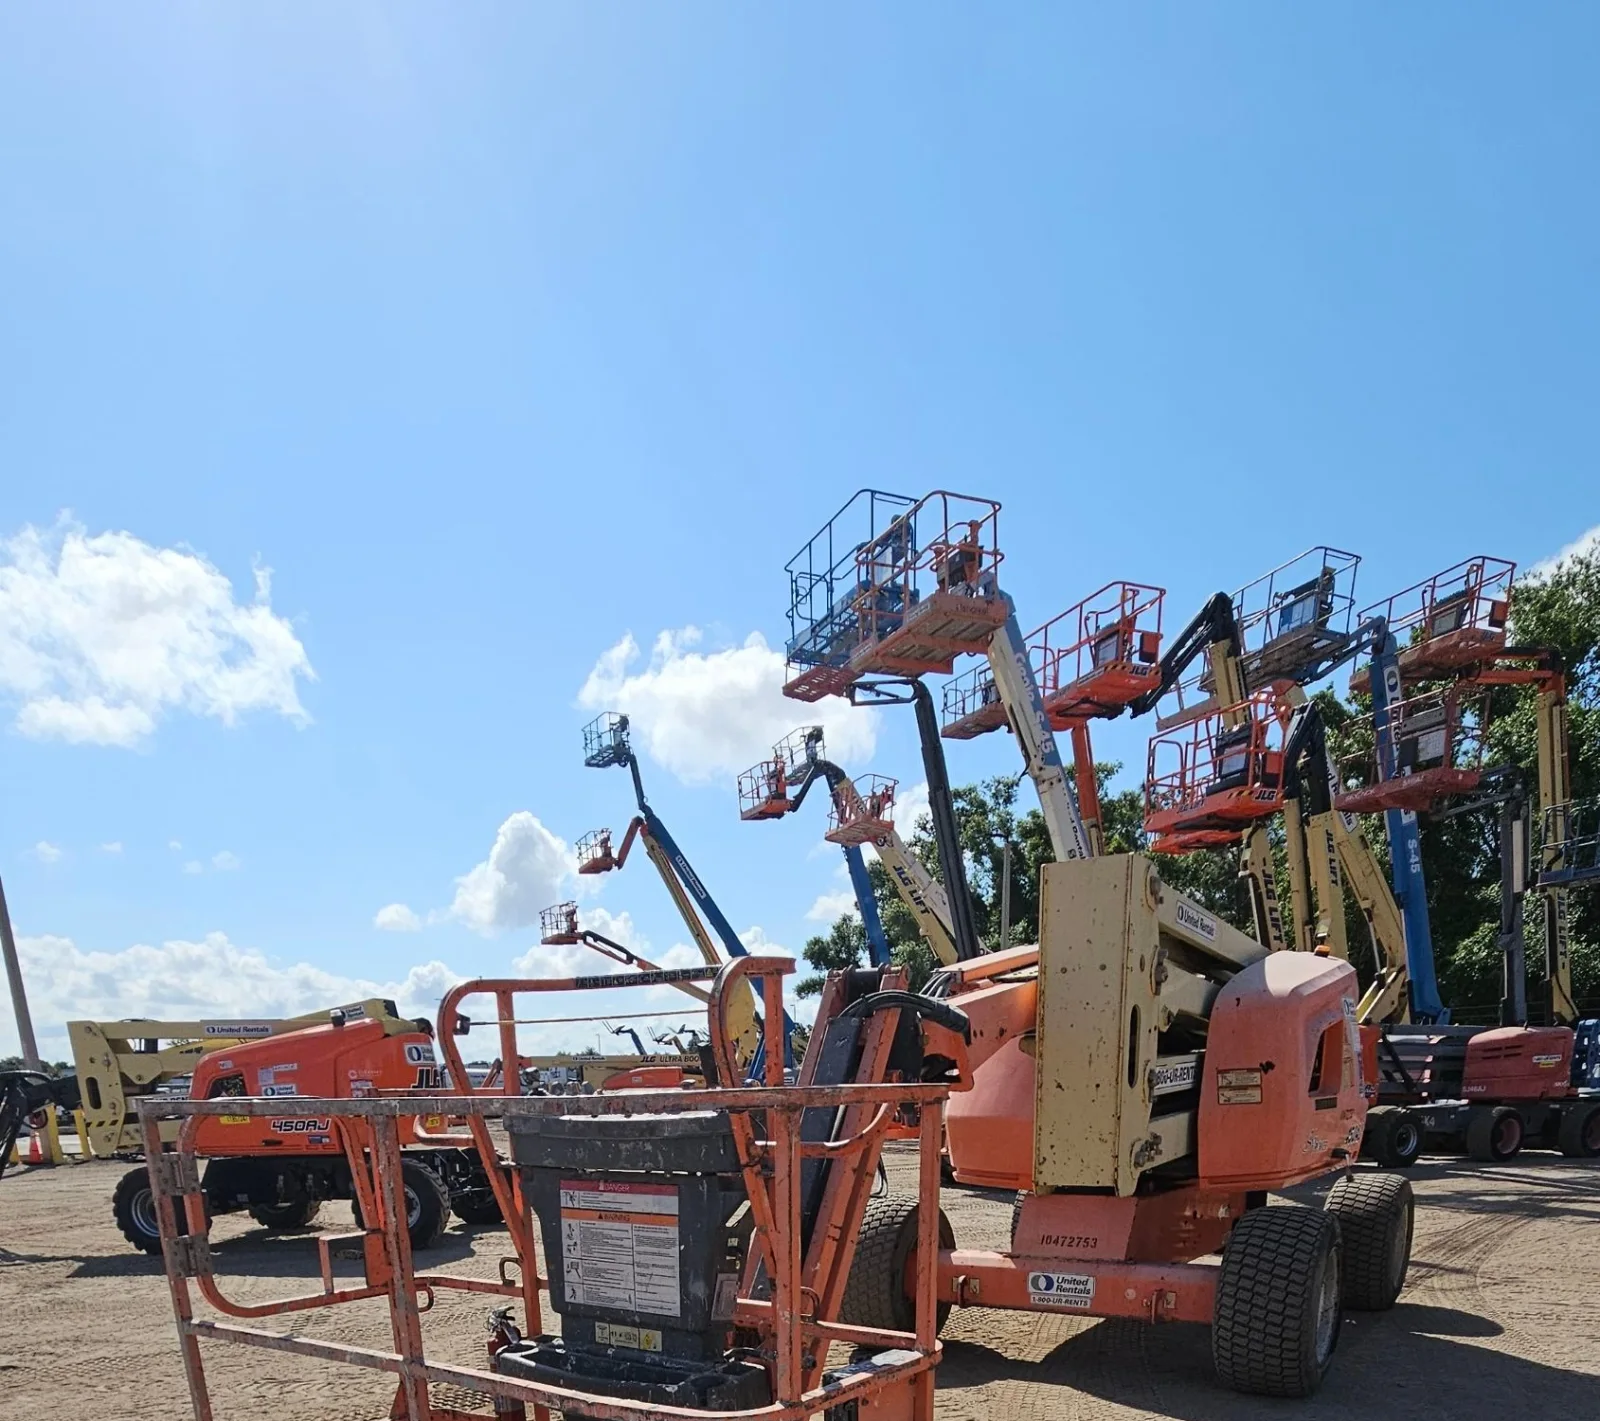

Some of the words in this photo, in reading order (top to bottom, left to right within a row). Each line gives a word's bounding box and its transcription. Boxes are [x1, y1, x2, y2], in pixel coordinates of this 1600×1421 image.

[1129, 666, 1149, 676] JLG
[1255, 790, 1275, 800] JLG
[1326, 829, 1335, 854] JLG
[1408, 838, 1421, 874] S-45
[1329, 858, 1339, 887] LIFT
[893, 865, 913, 887] JLG
[908, 890, 930, 914] LIFT
[1262, 869, 1277, 900] JLG
[1184, 909, 1199, 928] United
[1200, 917, 1215, 937] Rentals
[1268, 907, 1284, 943] LIFT
[217, 1025, 241, 1034] United
[242, 1025, 269, 1034] Rentals
[641, 1055, 656, 1063] JLG
[660, 1055, 682, 1063] ULTRA
[684, 1055, 700, 1063] 800
[272, 1119, 331, 1132] 450AJ
[1041, 1234, 1098, 1249] 10472753
[1056, 1275, 1090, 1286] United
[1055, 1284, 1091, 1296] Rentals
[1032, 1296, 1089, 1307] 1-800-UR-RENTS
